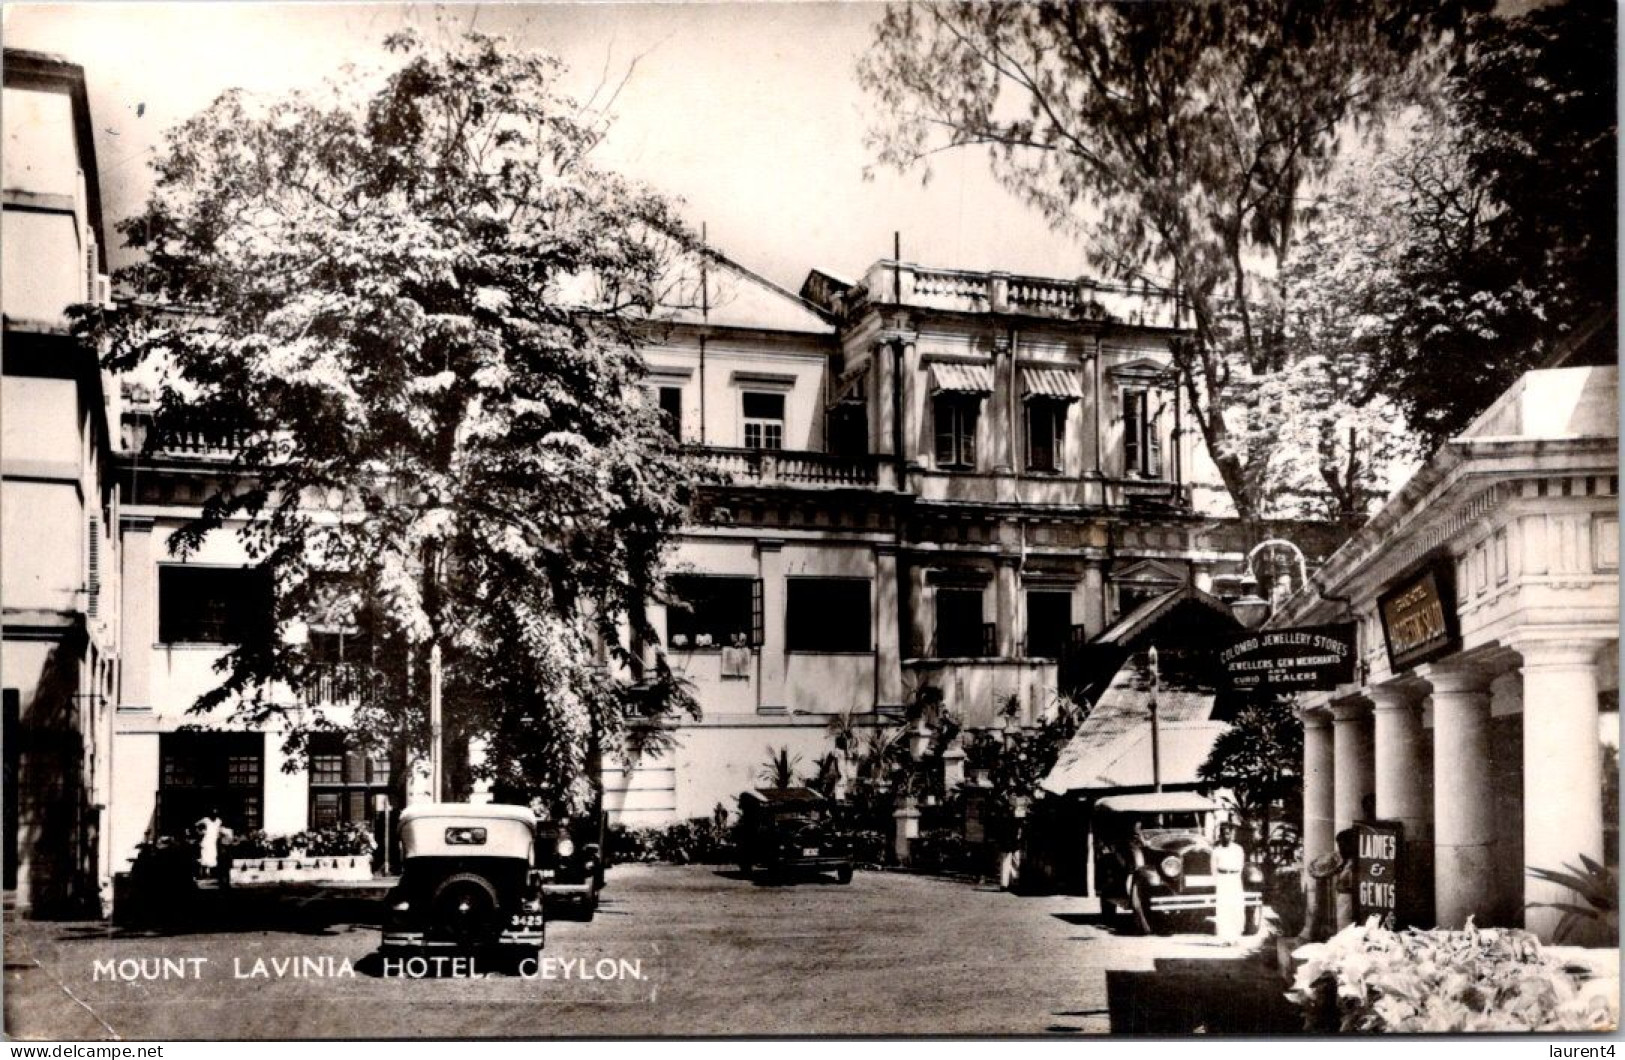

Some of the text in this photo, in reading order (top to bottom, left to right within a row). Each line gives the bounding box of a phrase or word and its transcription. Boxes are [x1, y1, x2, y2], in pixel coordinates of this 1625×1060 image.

[1220, 632, 1348, 664] COLOMBO JEWELLERY STORES
[1296, 654, 1341, 667] MERCHANTS
[1233, 673, 1317, 684] CURIO DEALERS
[1359, 834, 1396, 860] LADIES
[1369, 863, 1387, 877] &
[1359, 881, 1396, 908] GENTS
[511, 914, 543, 926] 3425
